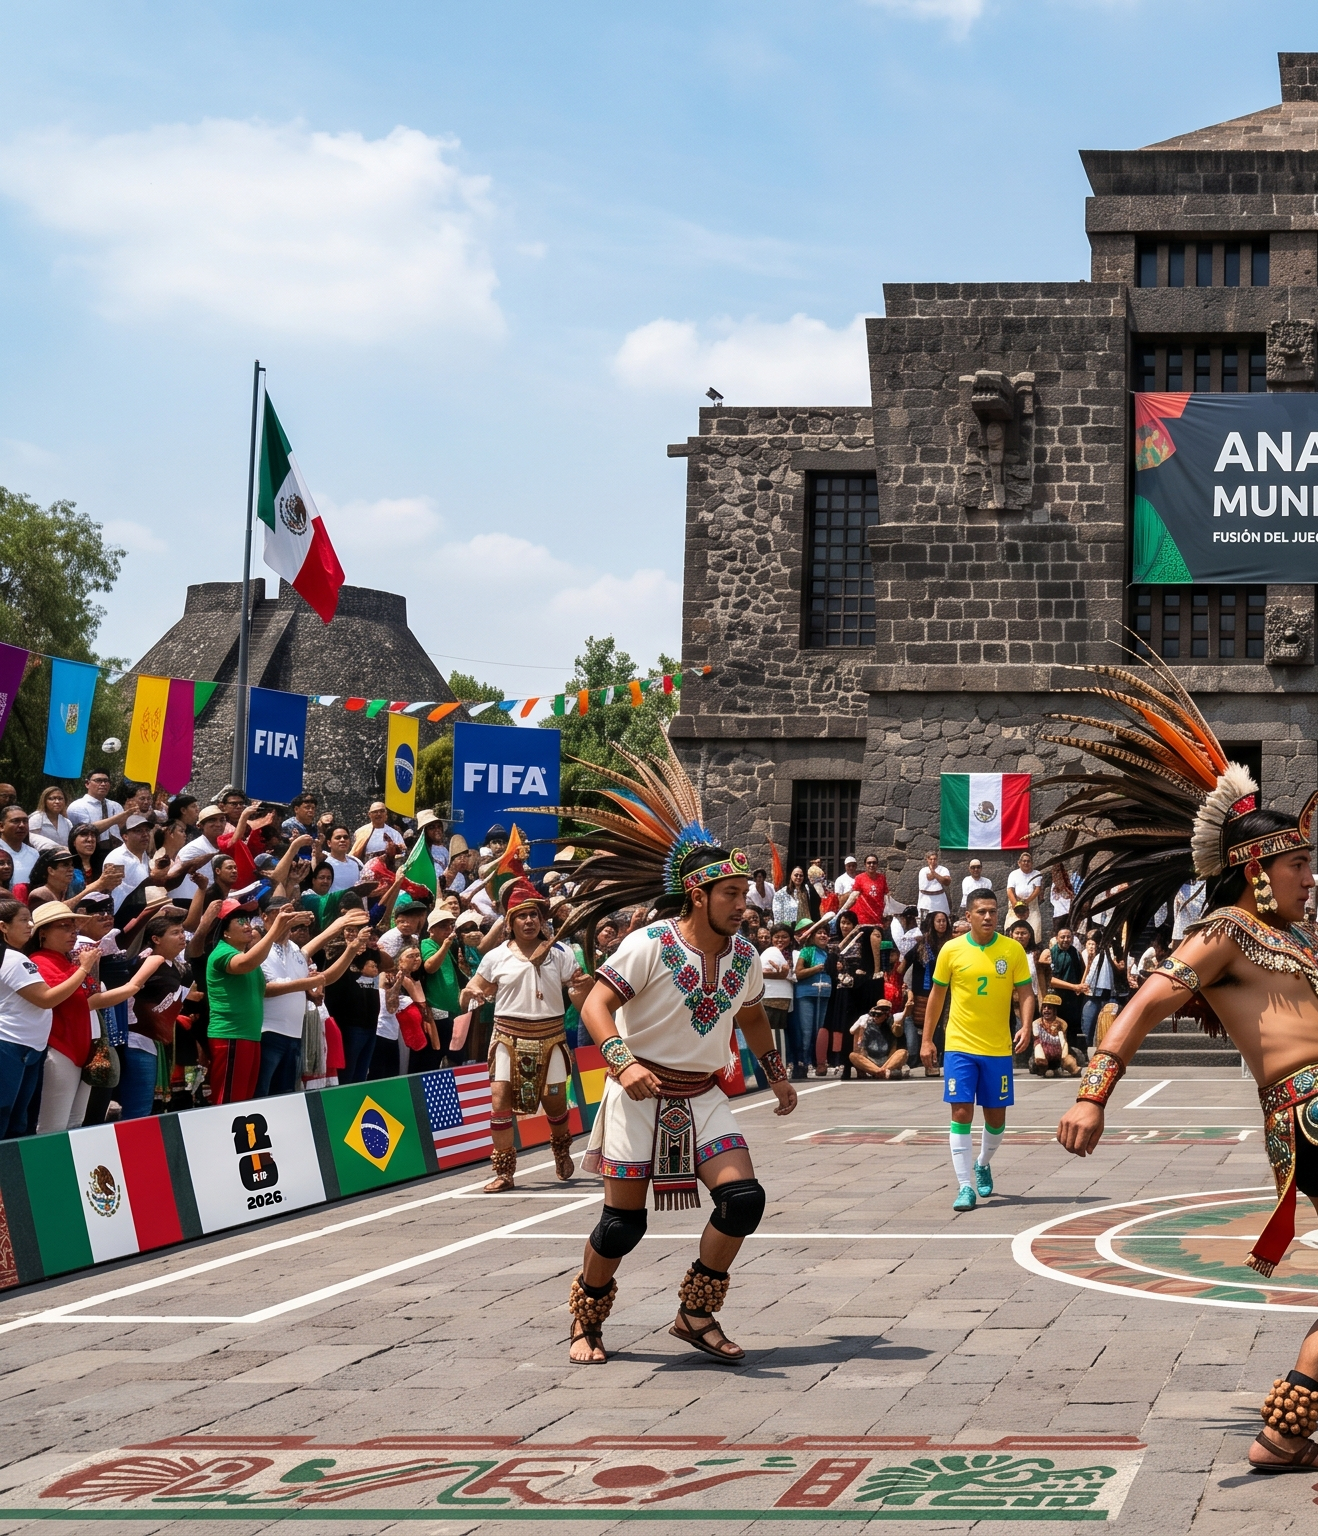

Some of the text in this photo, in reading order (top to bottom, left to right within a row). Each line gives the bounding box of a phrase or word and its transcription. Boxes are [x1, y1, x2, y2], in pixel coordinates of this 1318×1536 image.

[1212, 528, 1261, 543] FUSIÓN
[1264, 531, 1289, 543] DEL
[254, 729, 298, 759] FIFA
[463, 762, 548, 796] FIFA
[977, 976, 988, 996] 2
[247, 1190, 283, 1210] 2026
